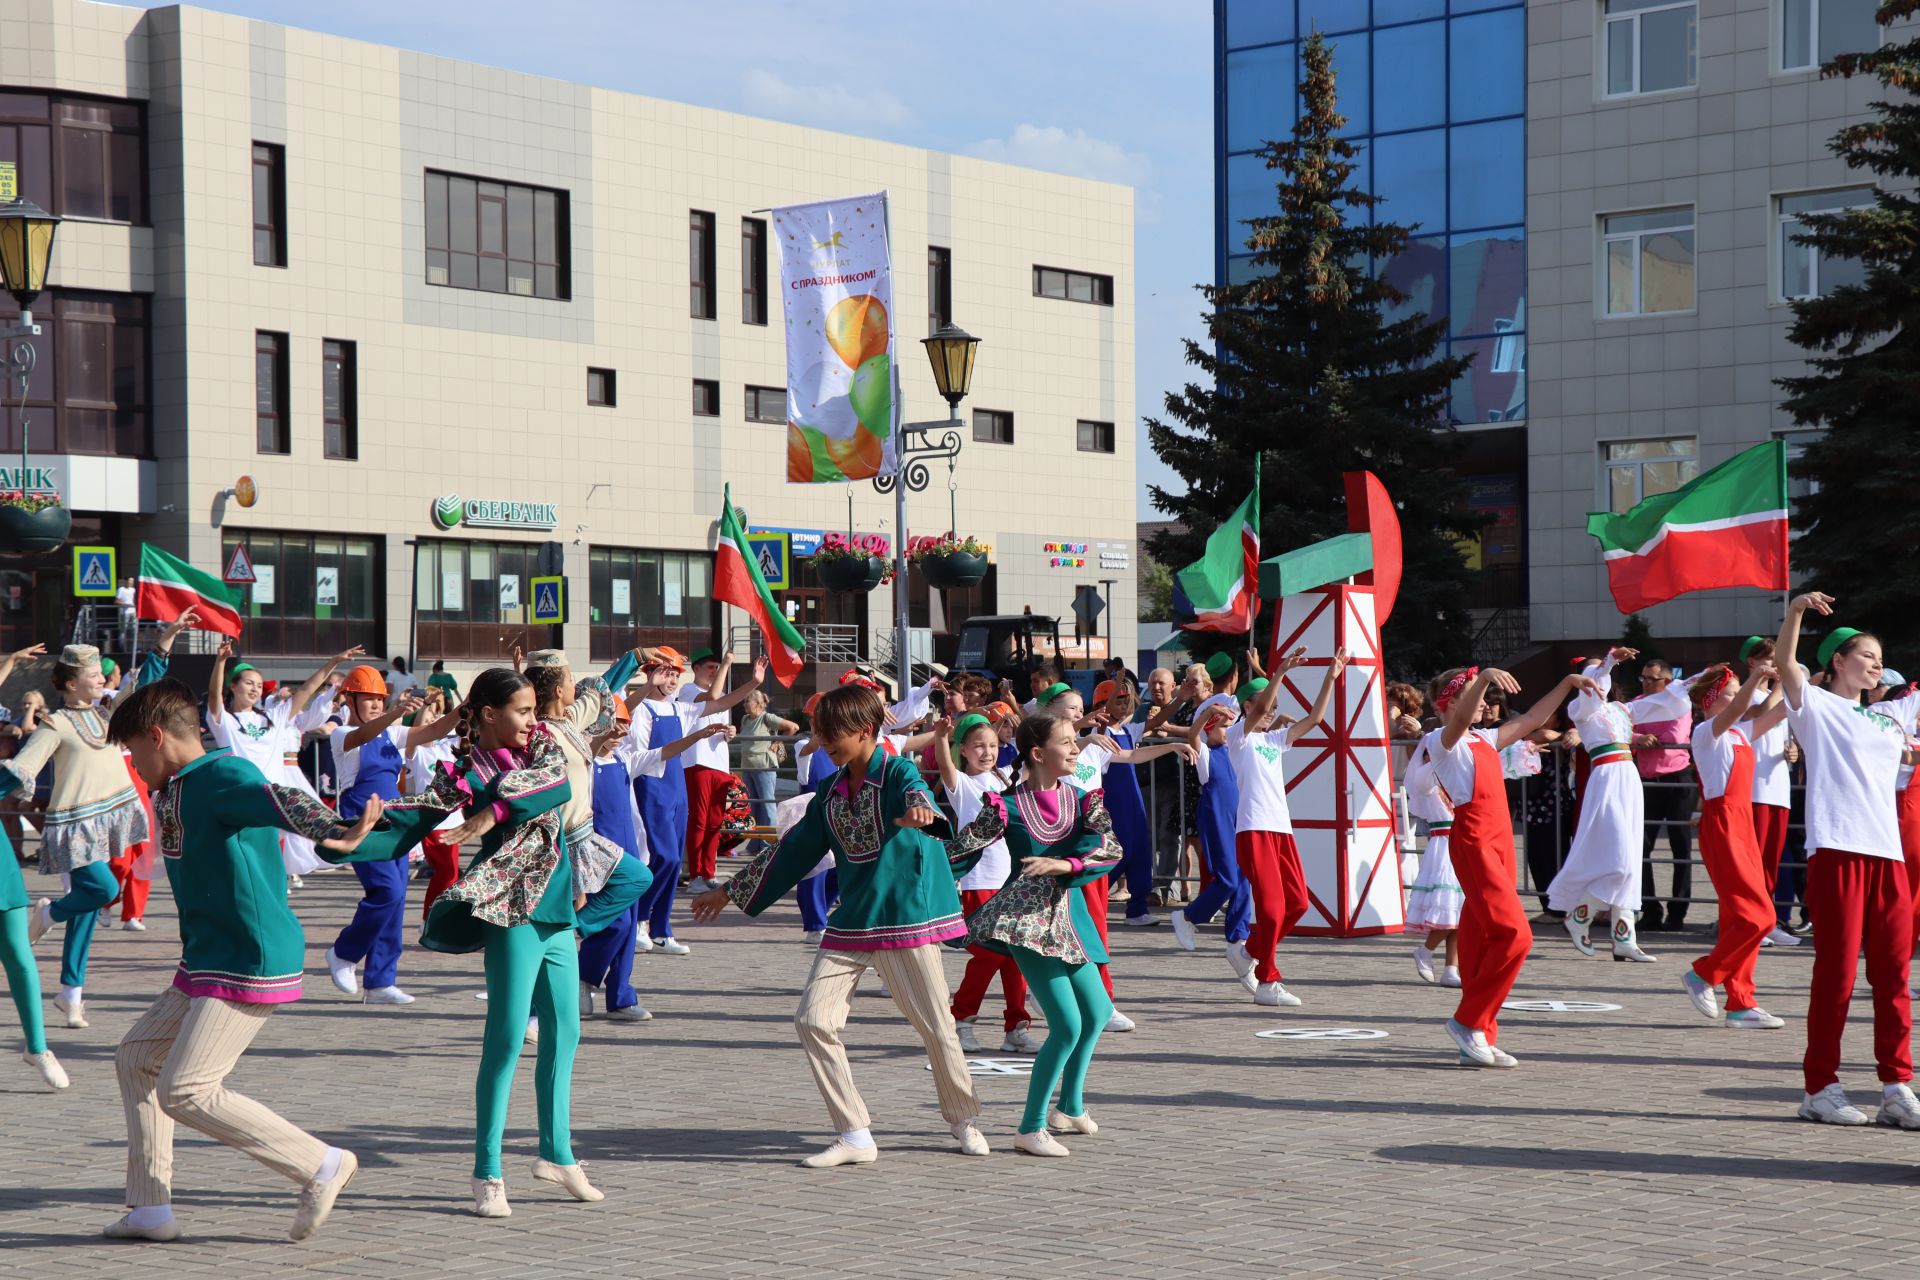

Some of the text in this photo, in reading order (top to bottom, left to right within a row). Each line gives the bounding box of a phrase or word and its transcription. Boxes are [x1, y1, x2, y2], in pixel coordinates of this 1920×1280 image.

[791, 269, 876, 289] С ПРАЗДНИКОМ!
[466, 499, 557, 523] СБЕРБАНК
